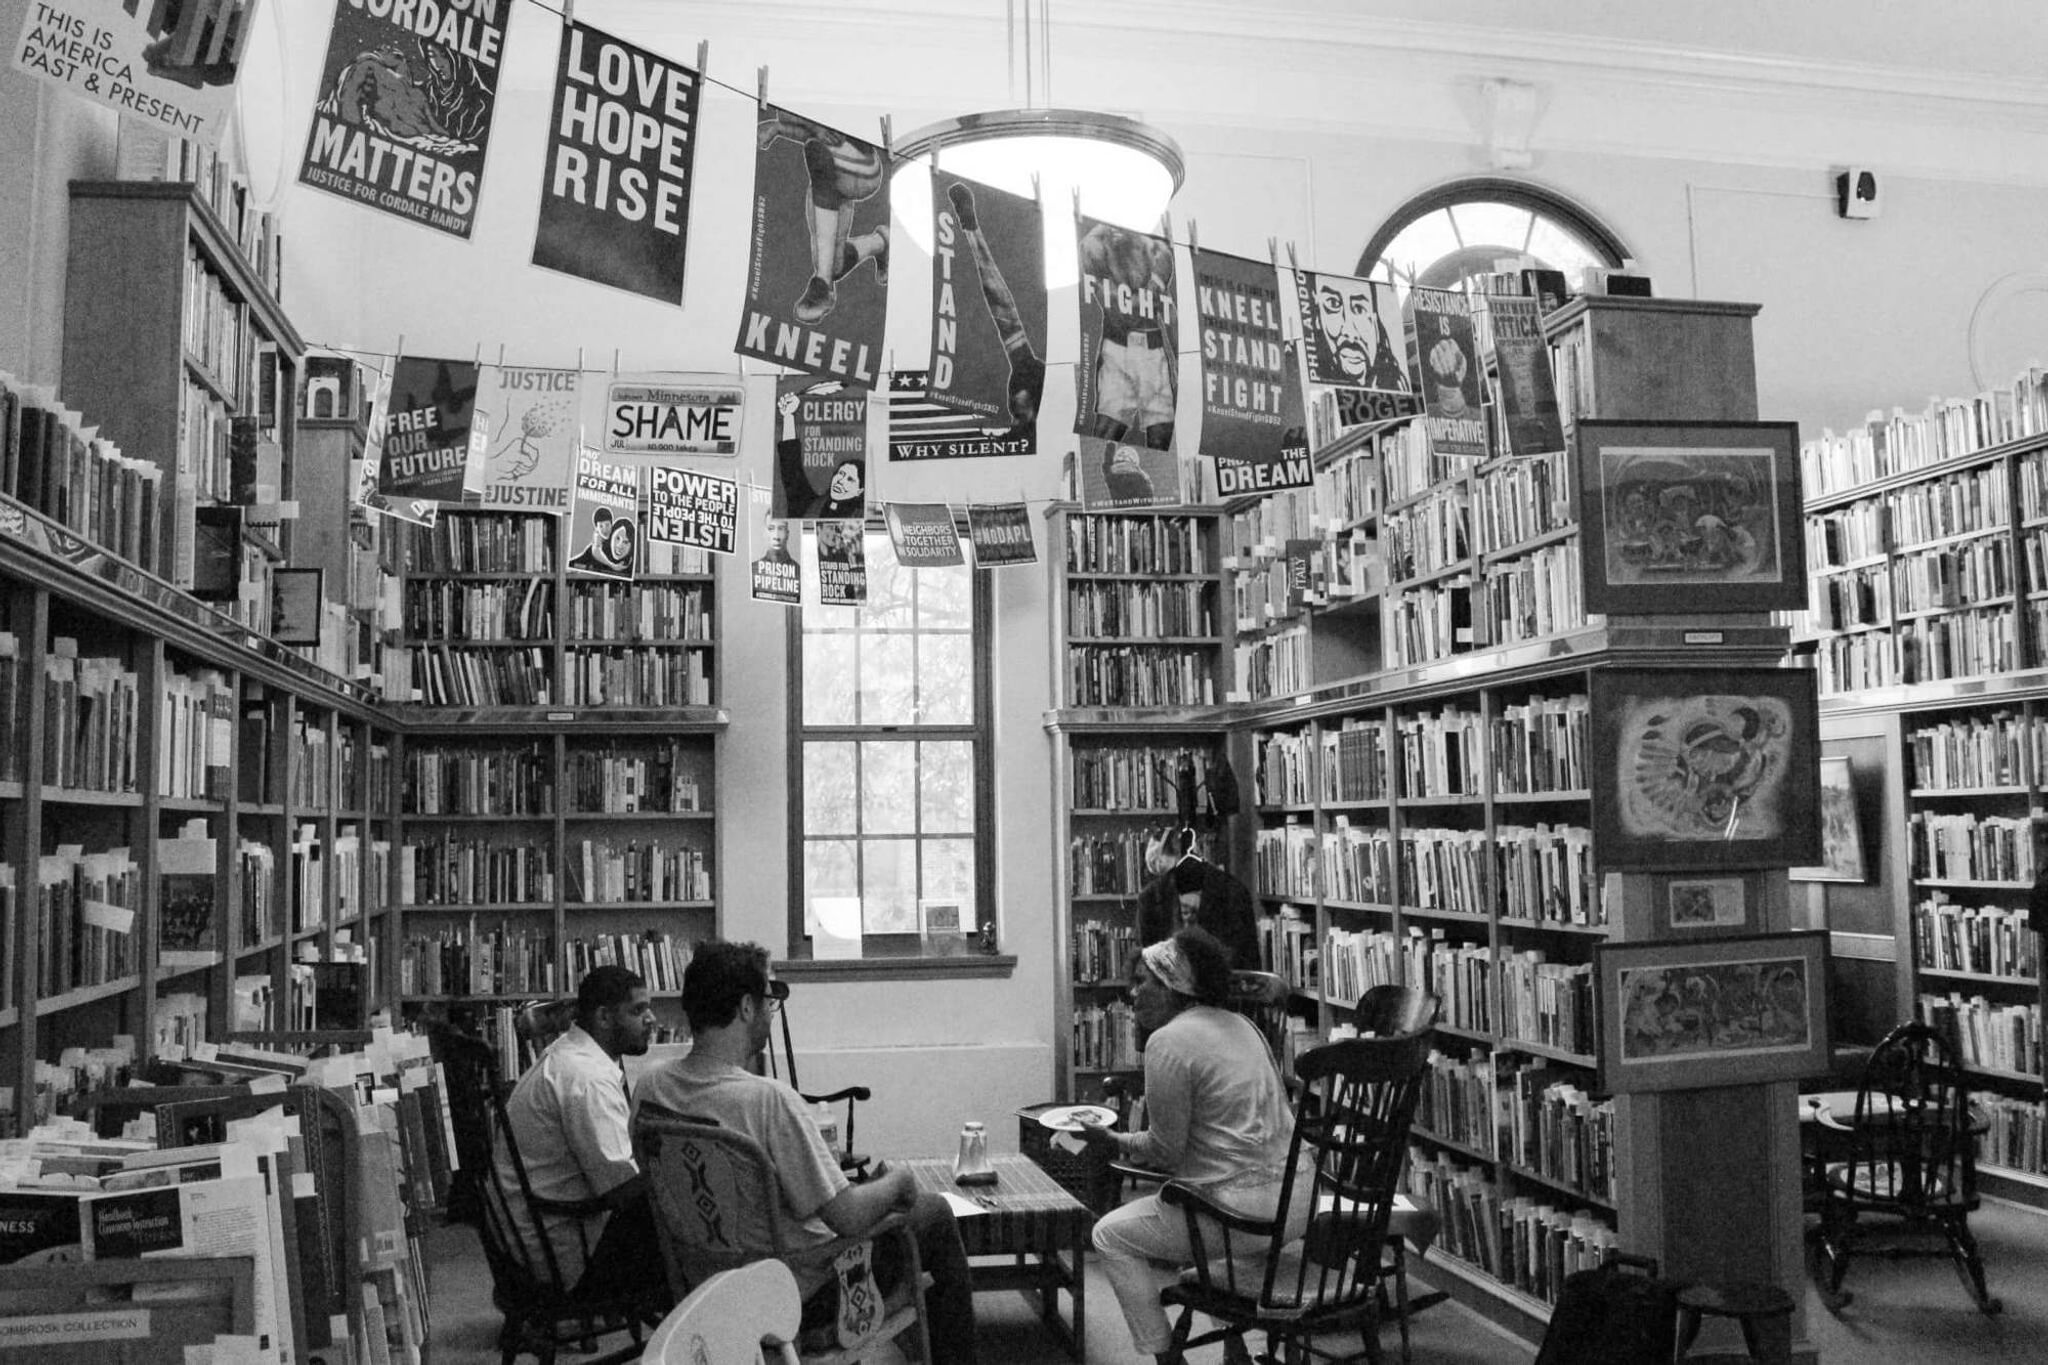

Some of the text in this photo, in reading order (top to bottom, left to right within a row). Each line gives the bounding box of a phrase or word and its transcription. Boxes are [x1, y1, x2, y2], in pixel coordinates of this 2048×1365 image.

[37, 3, 113, 50] THIS IS
[27, 26, 132, 84] AMERICA
[566, 28, 693, 123] LOVE
[21, 44, 205, 134] PAST & PRESENT
[560, 83, 688, 184] HOPE
[309, 117, 476, 215] MATTERS
[306, 166, 468, 232] JUSTICE FOR CORDALE HANDY
[552, 143, 684, 236] RISE
[934, 211, 957, 391] STAND
[1083, 274, 1175, 325] FIGHT
[1199, 286, 1280, 330] KNEEL
[1297, 271, 1318, 381] PHILANDO
[1438, 315, 1451, 337] IS
[1493, 315, 1540, 338] ATTICA
[744, 312, 872, 382] KNEEL
[1204, 329, 1282, 372] STAND
[498, 370, 575, 392] JUSTICE
[1206, 372, 1282, 414] FIGHT
[647, 389, 711, 403] Minnesota
[386, 407, 438, 435] FREE
[612, 404, 734, 441] SHAME
[803, 400, 865, 422] CLERGY
[388, 431, 429, 457] OUR
[804, 426, 821, 438] FOR
[804, 436, 862, 453] STANDING
[390, 445, 467, 480] FUTURE
[803, 452, 835, 467] ROCK
[896, 439, 1030, 460] WHY SILENT?
[1281, 446, 1308, 460] THE
[579, 456, 635, 487] DREAM
[1219, 458, 1311, 494] DREAM
[491, 484, 569, 506] JUSTINE
[578, 487, 635, 512] IMMIGRANTS
[579, 476, 636, 498] FOR ALL
[652, 468, 736, 506] POWER
[652, 490, 735, 516] TO THE PEOPLE
[652, 503, 734, 529] TO THE PEOPLE
[651, 516, 734, 551] LISTEN
[902, 524, 952, 536] NEIGHBORS
[905, 535, 955, 547] TOGETHER
[906, 545, 957, 557] SOLIDARITY
[758, 561, 795, 579] PRISON
[820, 570, 866, 586] STANDING
[1295, 555, 1307, 590] ITALY
[754, 574, 800, 593] PIPELINE
[822, 583, 847, 599] ROCK
[62, 1318, 138, 1333] COLLECTION
